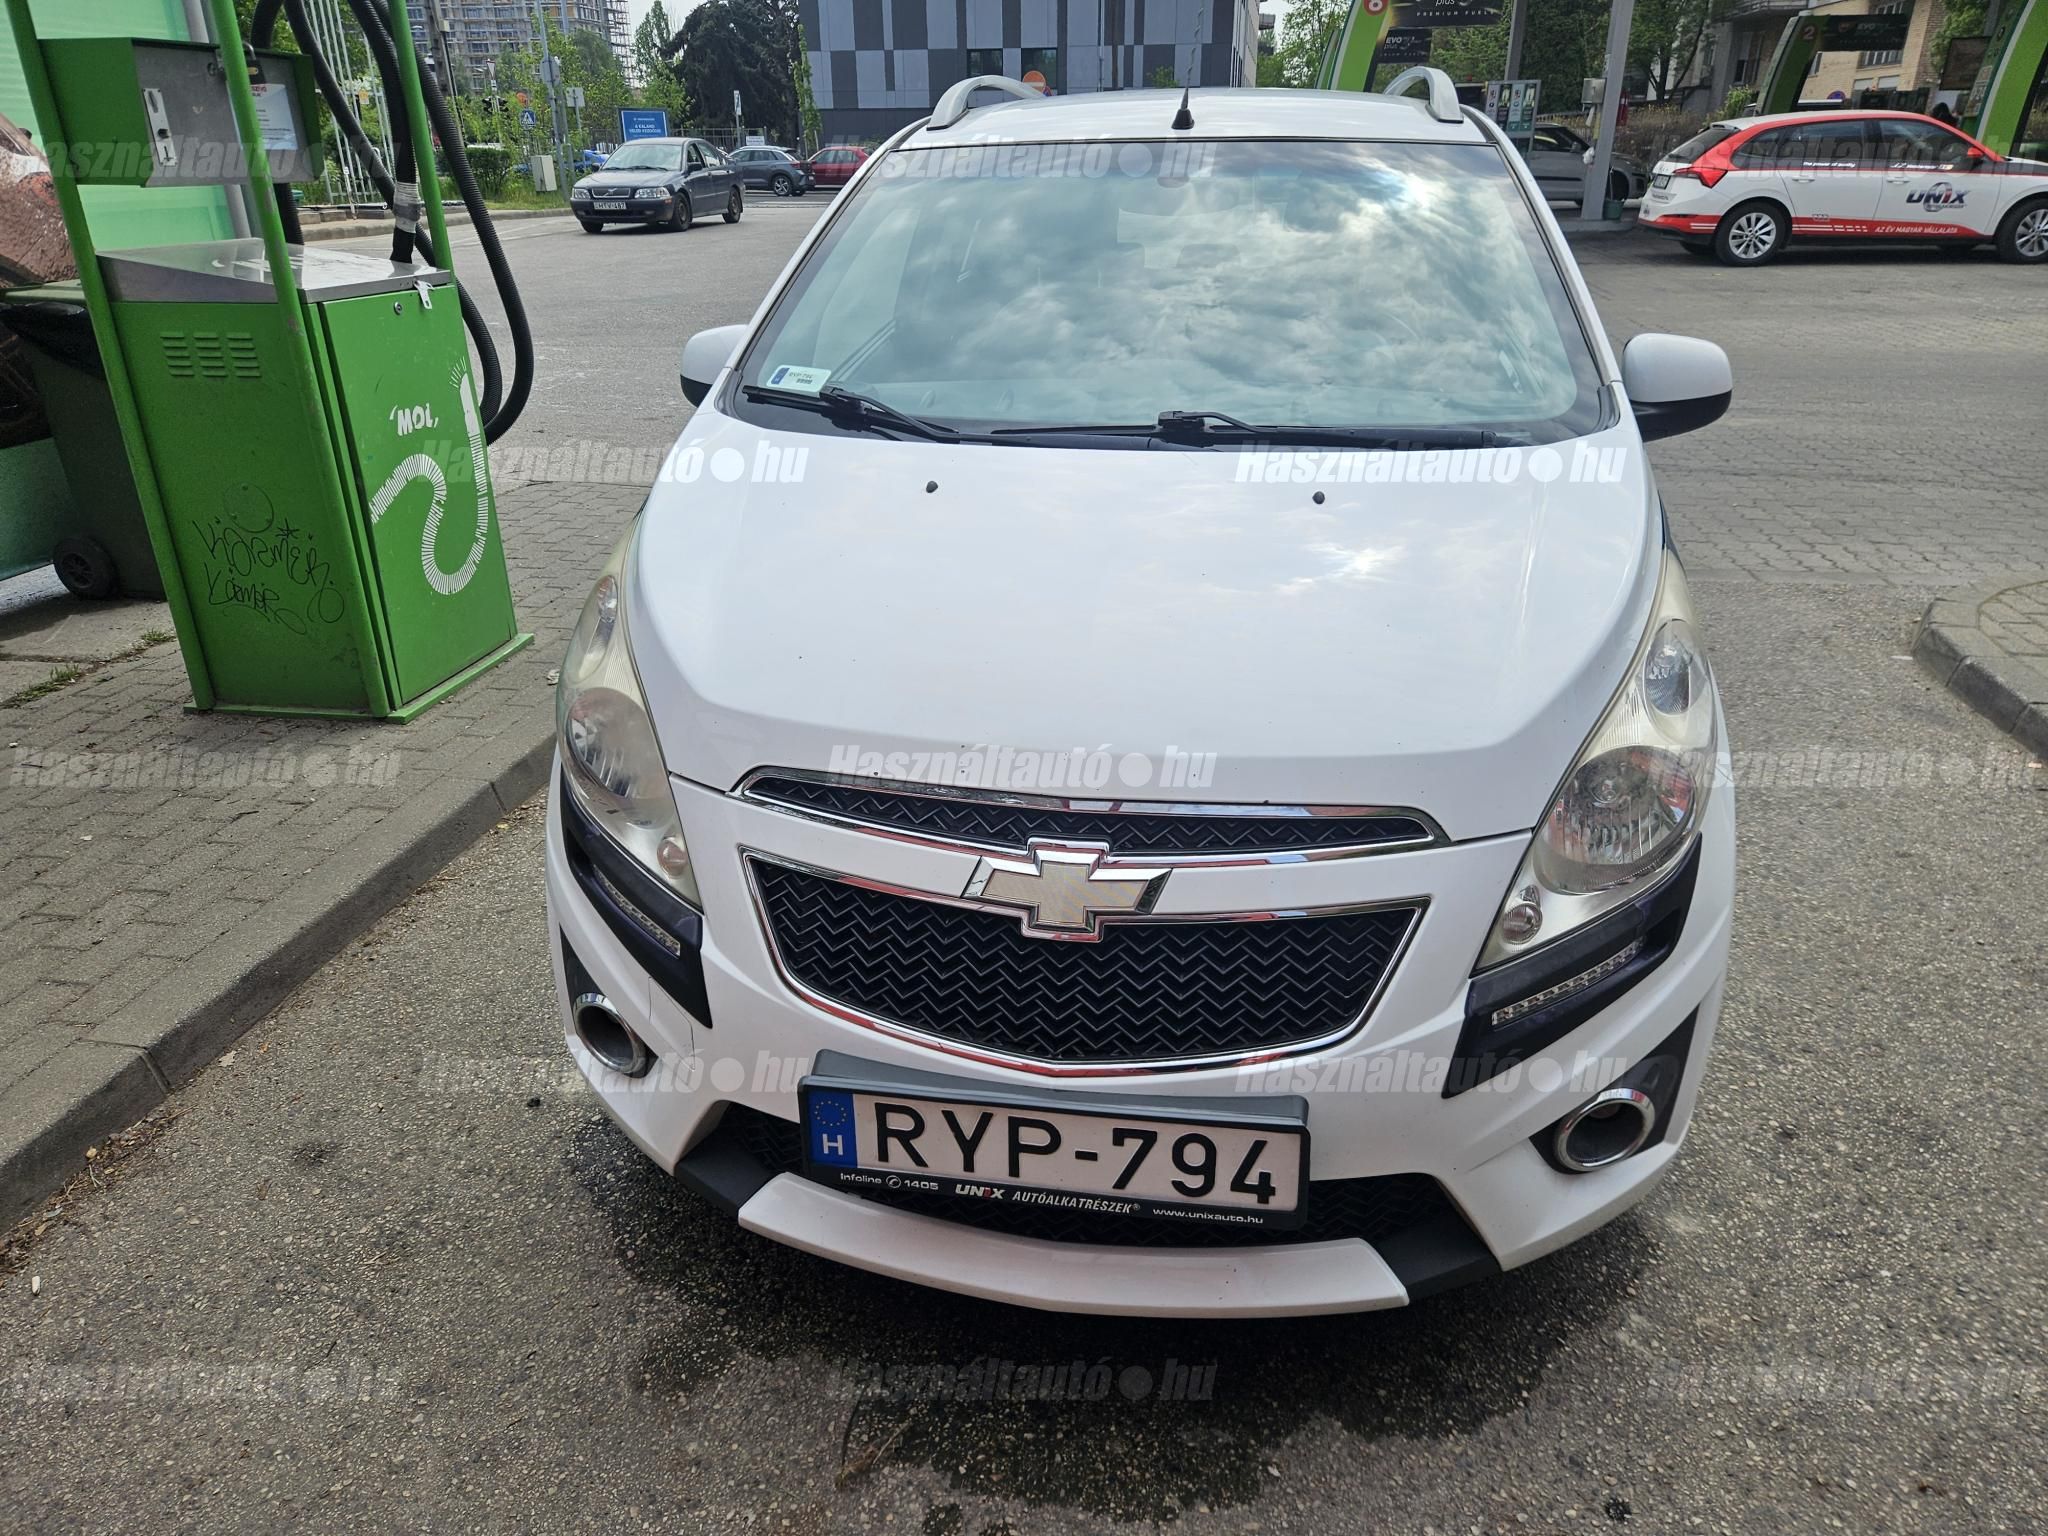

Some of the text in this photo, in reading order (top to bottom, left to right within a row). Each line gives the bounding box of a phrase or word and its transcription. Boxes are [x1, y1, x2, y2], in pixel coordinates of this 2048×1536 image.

[1803, 26, 1814, 40] 2
[822, 1134, 844, 1156] H
[874, 1101, 1276, 1205] RYP-794
[840, 1172, 882, 1185] Infoline
[904, 1179, 940, 1191] 1405
[955, 1183, 1006, 1199] UNIX
[1153, 1207, 1264, 1225] www.unixauto.hu
